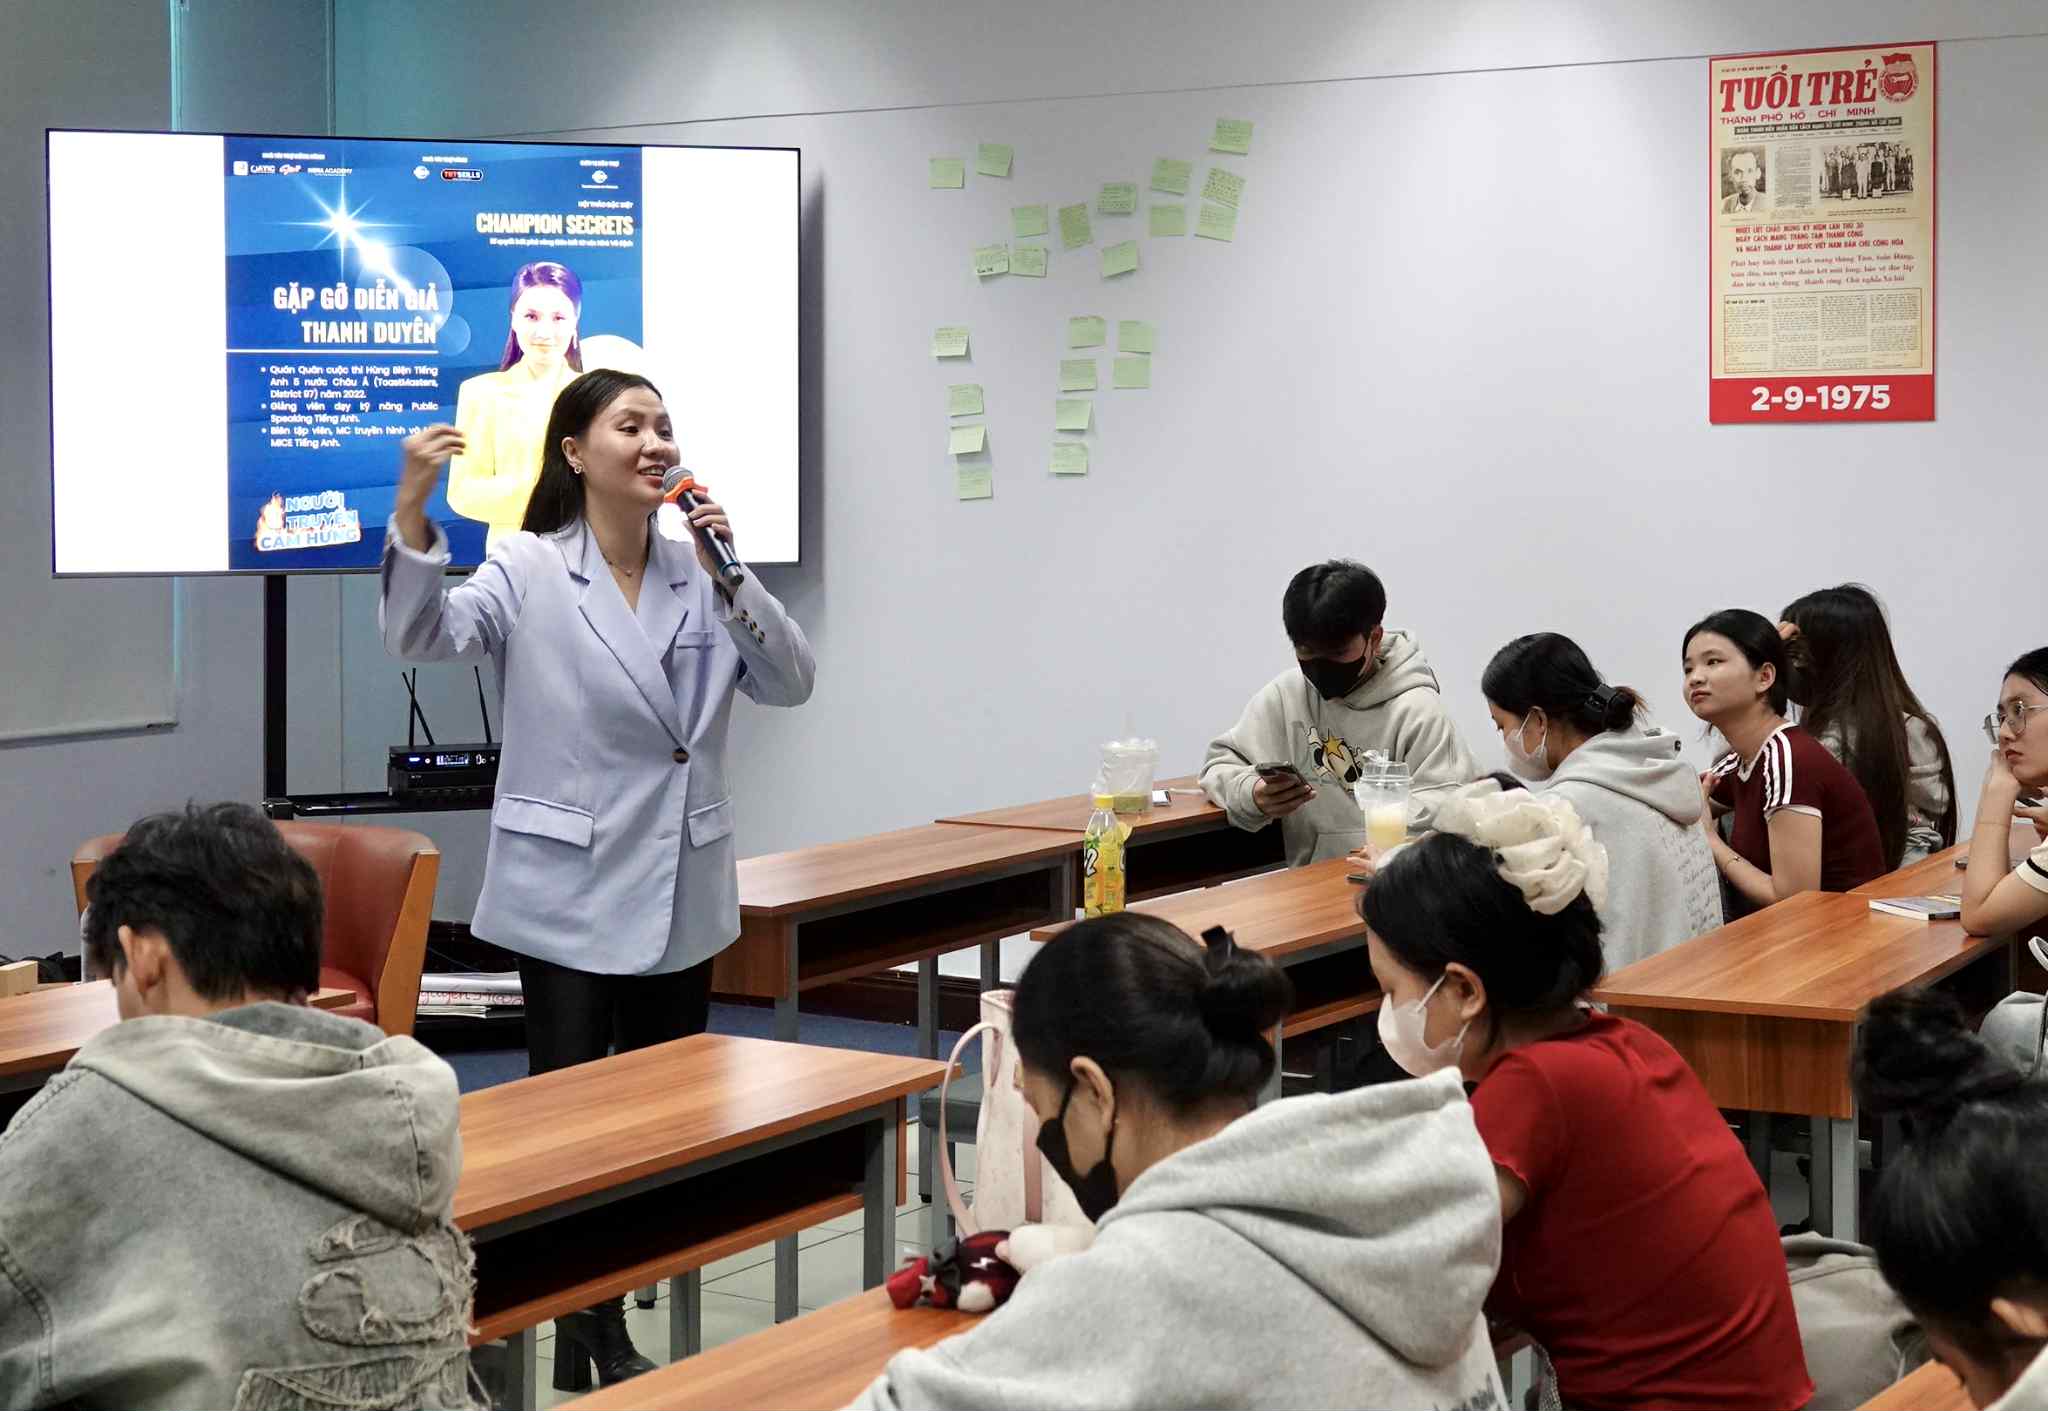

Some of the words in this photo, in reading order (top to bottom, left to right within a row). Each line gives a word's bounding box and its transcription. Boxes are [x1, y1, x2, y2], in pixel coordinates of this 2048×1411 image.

[1720, 64, 1803, 112] TUỔI
[1807, 59, 1878, 106] TRẺ
[1847, 106, 1876, 116] MINH
[476, 212, 563, 234] CHAMPION
[566, 215, 634, 236] SECRETS
[273, 282, 316, 314] GẶP
[320, 282, 349, 310] GỠ
[355, 279, 399, 310] DIỄN
[301, 321, 368, 343] THANH
[374, 316, 437, 343] DUYÊN
[270, 378, 288, 387] Anh
[1751, 384, 1891, 411] 2-9-1975
[271, 414, 312, 425] Speaking
[314, 413, 339, 425] Tiếng
[340, 414, 360, 423] Anh.
